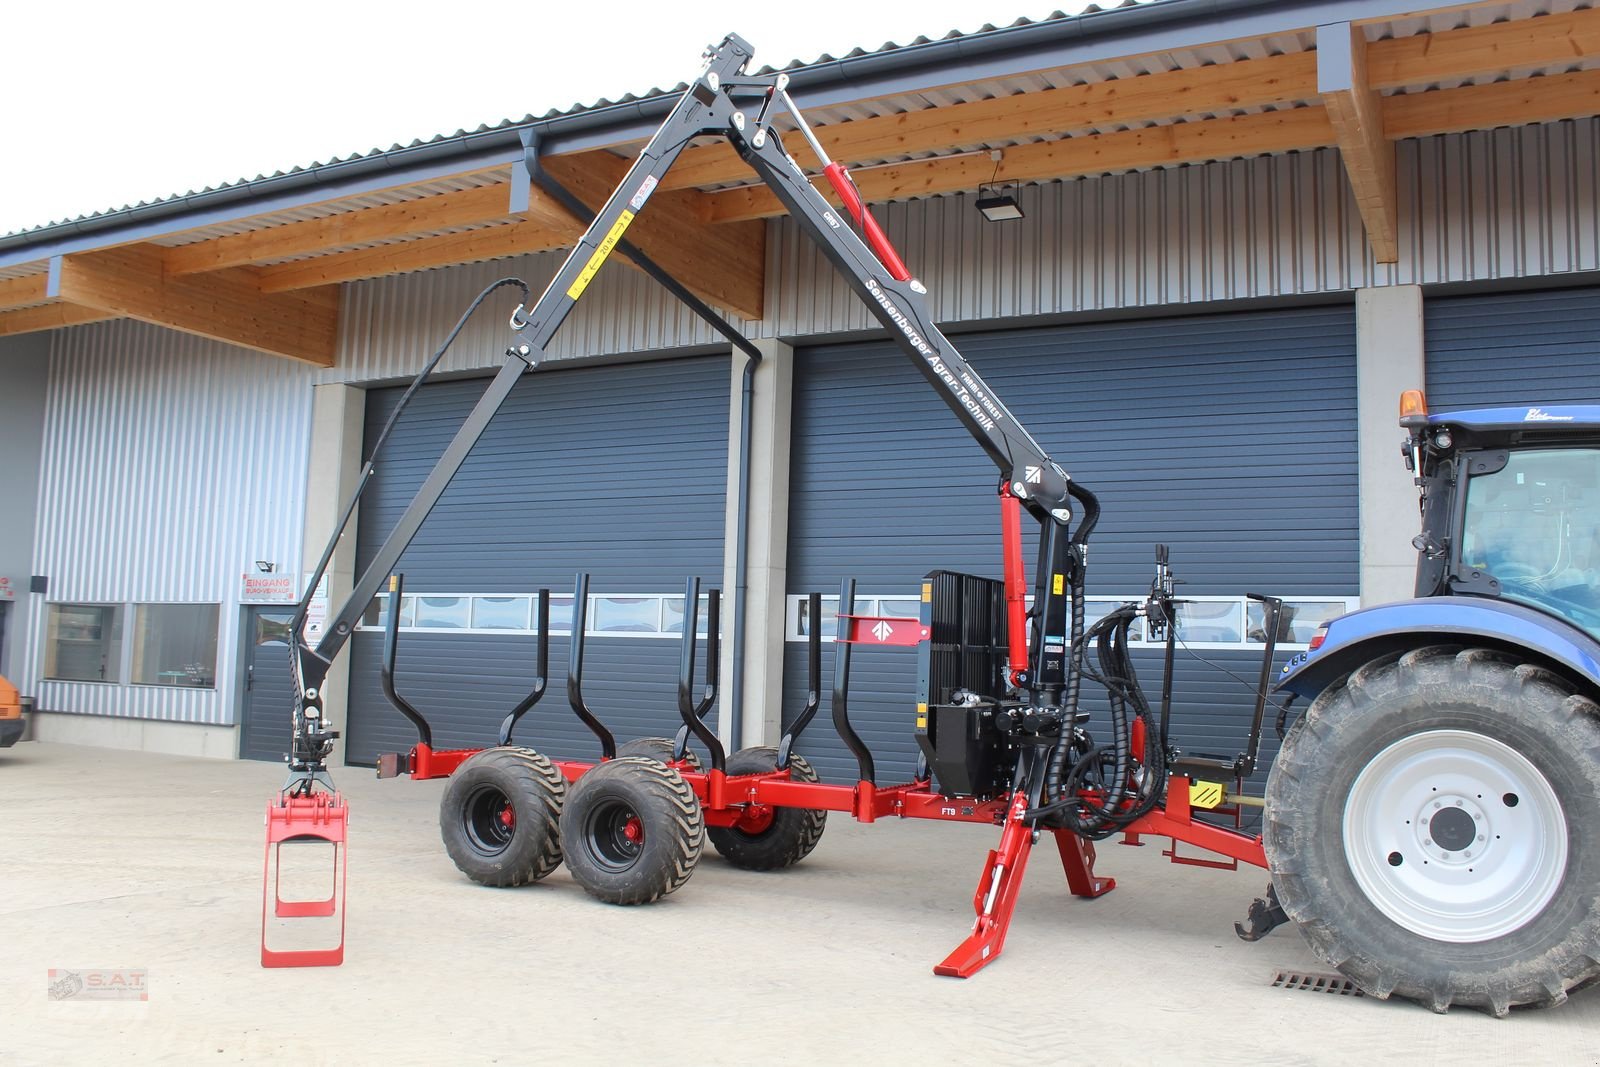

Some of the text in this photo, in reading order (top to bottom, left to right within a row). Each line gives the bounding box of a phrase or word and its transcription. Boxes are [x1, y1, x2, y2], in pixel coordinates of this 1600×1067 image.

[600, 245, 609, 255] 20
[865, 279, 995, 432] Sensenberger Agrar-Technik
[961, 372, 1003, 420] FARMI FOREST
[245, 578, 290, 587] EINGANG
[941, 807, 956, 816] FT9
